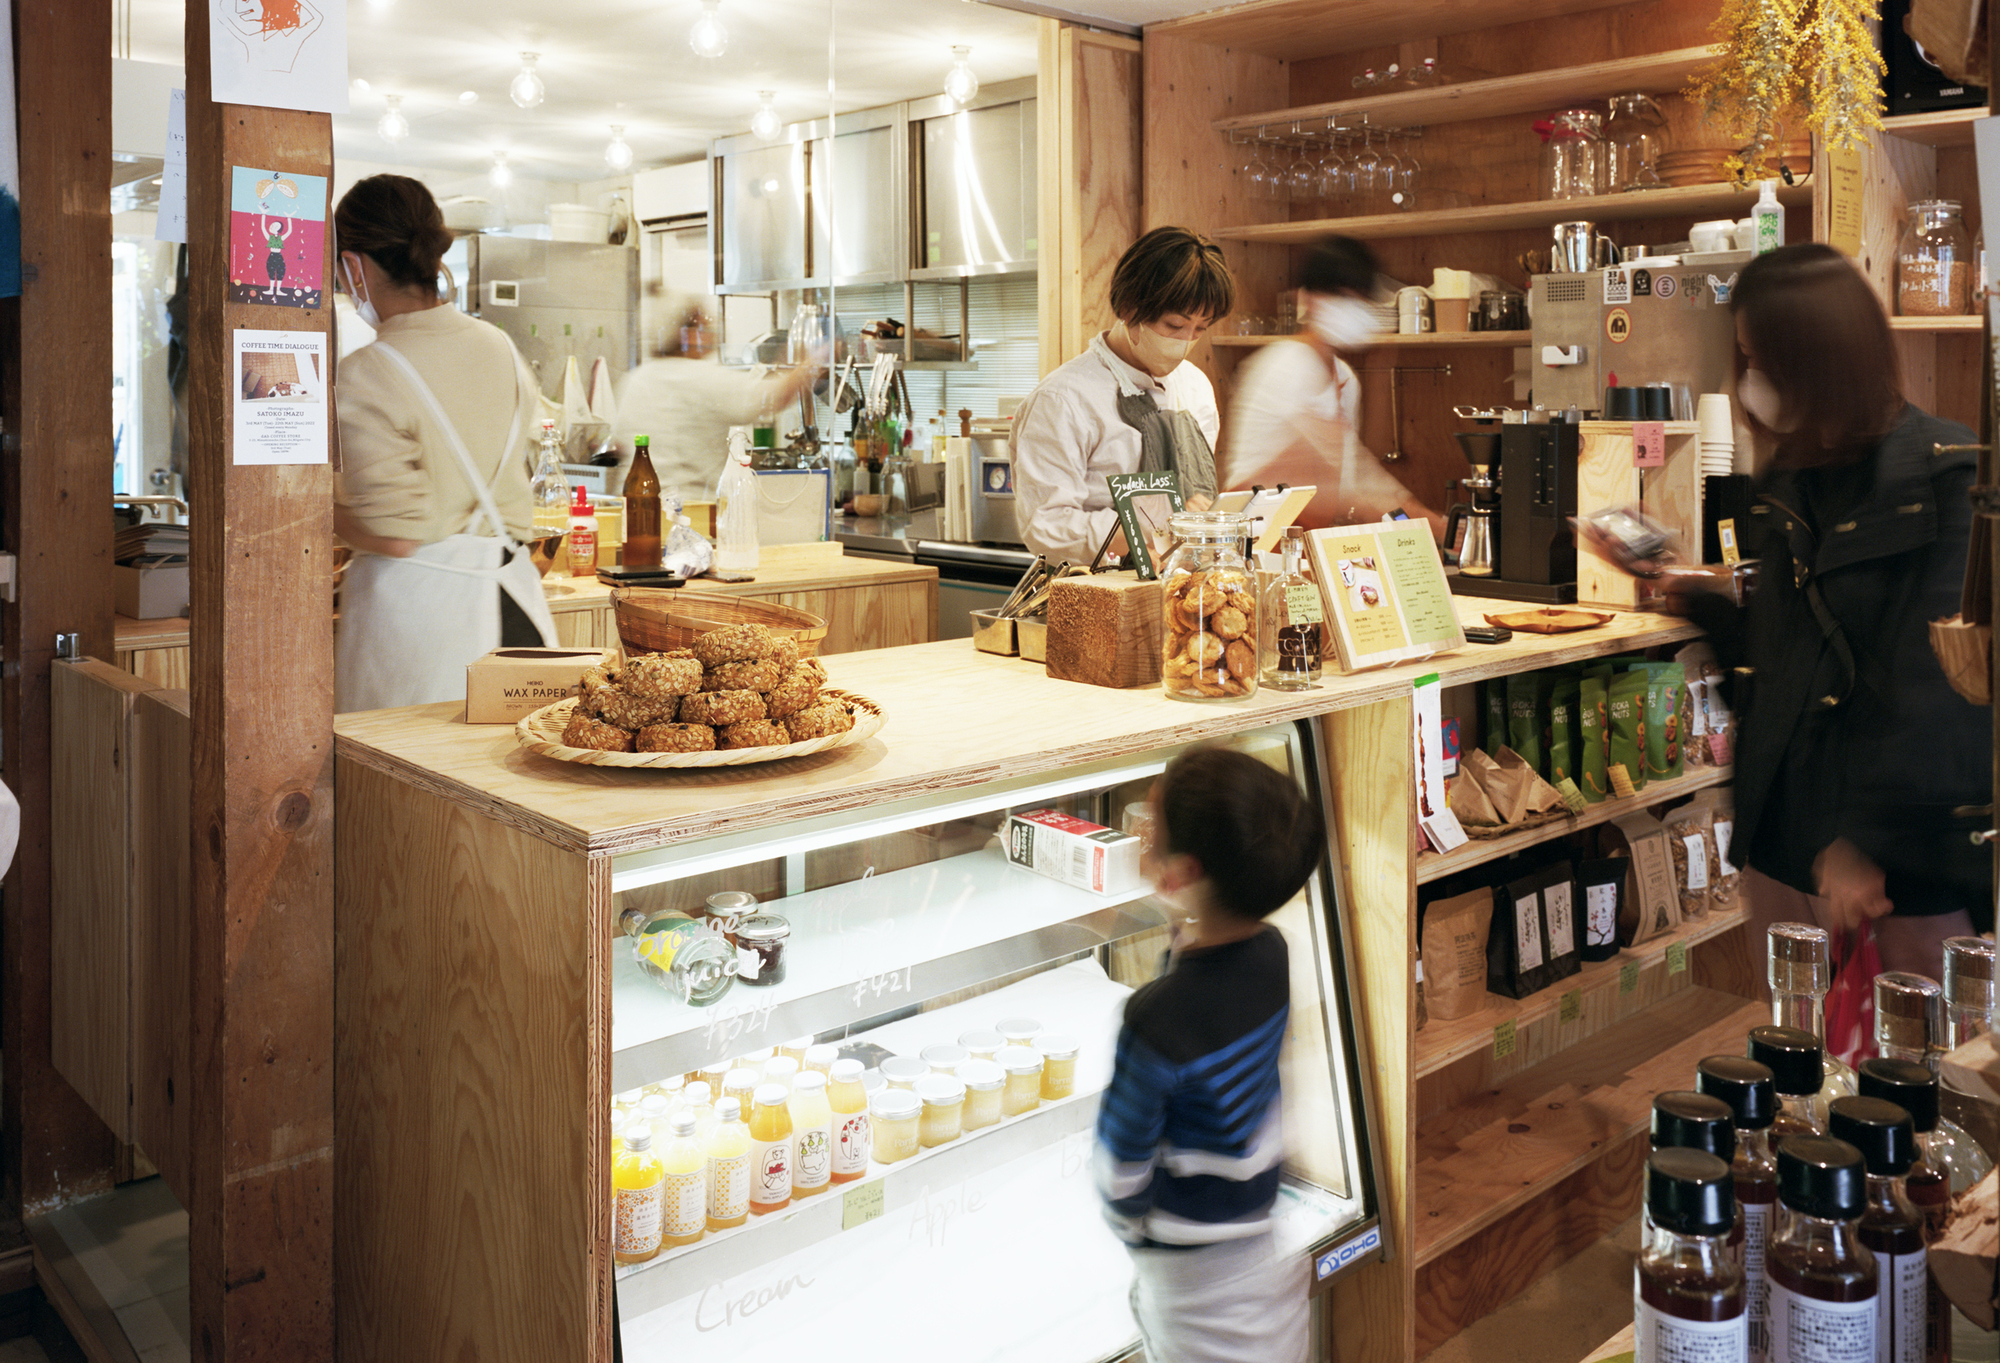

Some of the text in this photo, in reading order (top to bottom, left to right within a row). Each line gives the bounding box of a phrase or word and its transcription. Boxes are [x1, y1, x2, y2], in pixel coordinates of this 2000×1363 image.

[1939, 86, 1964, 97] YAMAHA
[1681, 274, 1706, 290] night
[1342, 544, 1361, 554] Snack
[1397, 538, 1416, 548] Drinks
[503, 688, 567, 698] WAX PAPER
[1610, 700, 1630, 711] BOKA
[1512, 709, 1536, 718] NUTS
[1611, 709, 1630, 719] NUTS
[633, 914, 749, 962] orange
[673, 957, 767, 1006] juic
[852, 964, 912, 1008] ¥421
[702, 991, 778, 1050] ¥324
[908, 1179, 988, 1248] Apple
[694, 1273, 816, 1333] Cream
